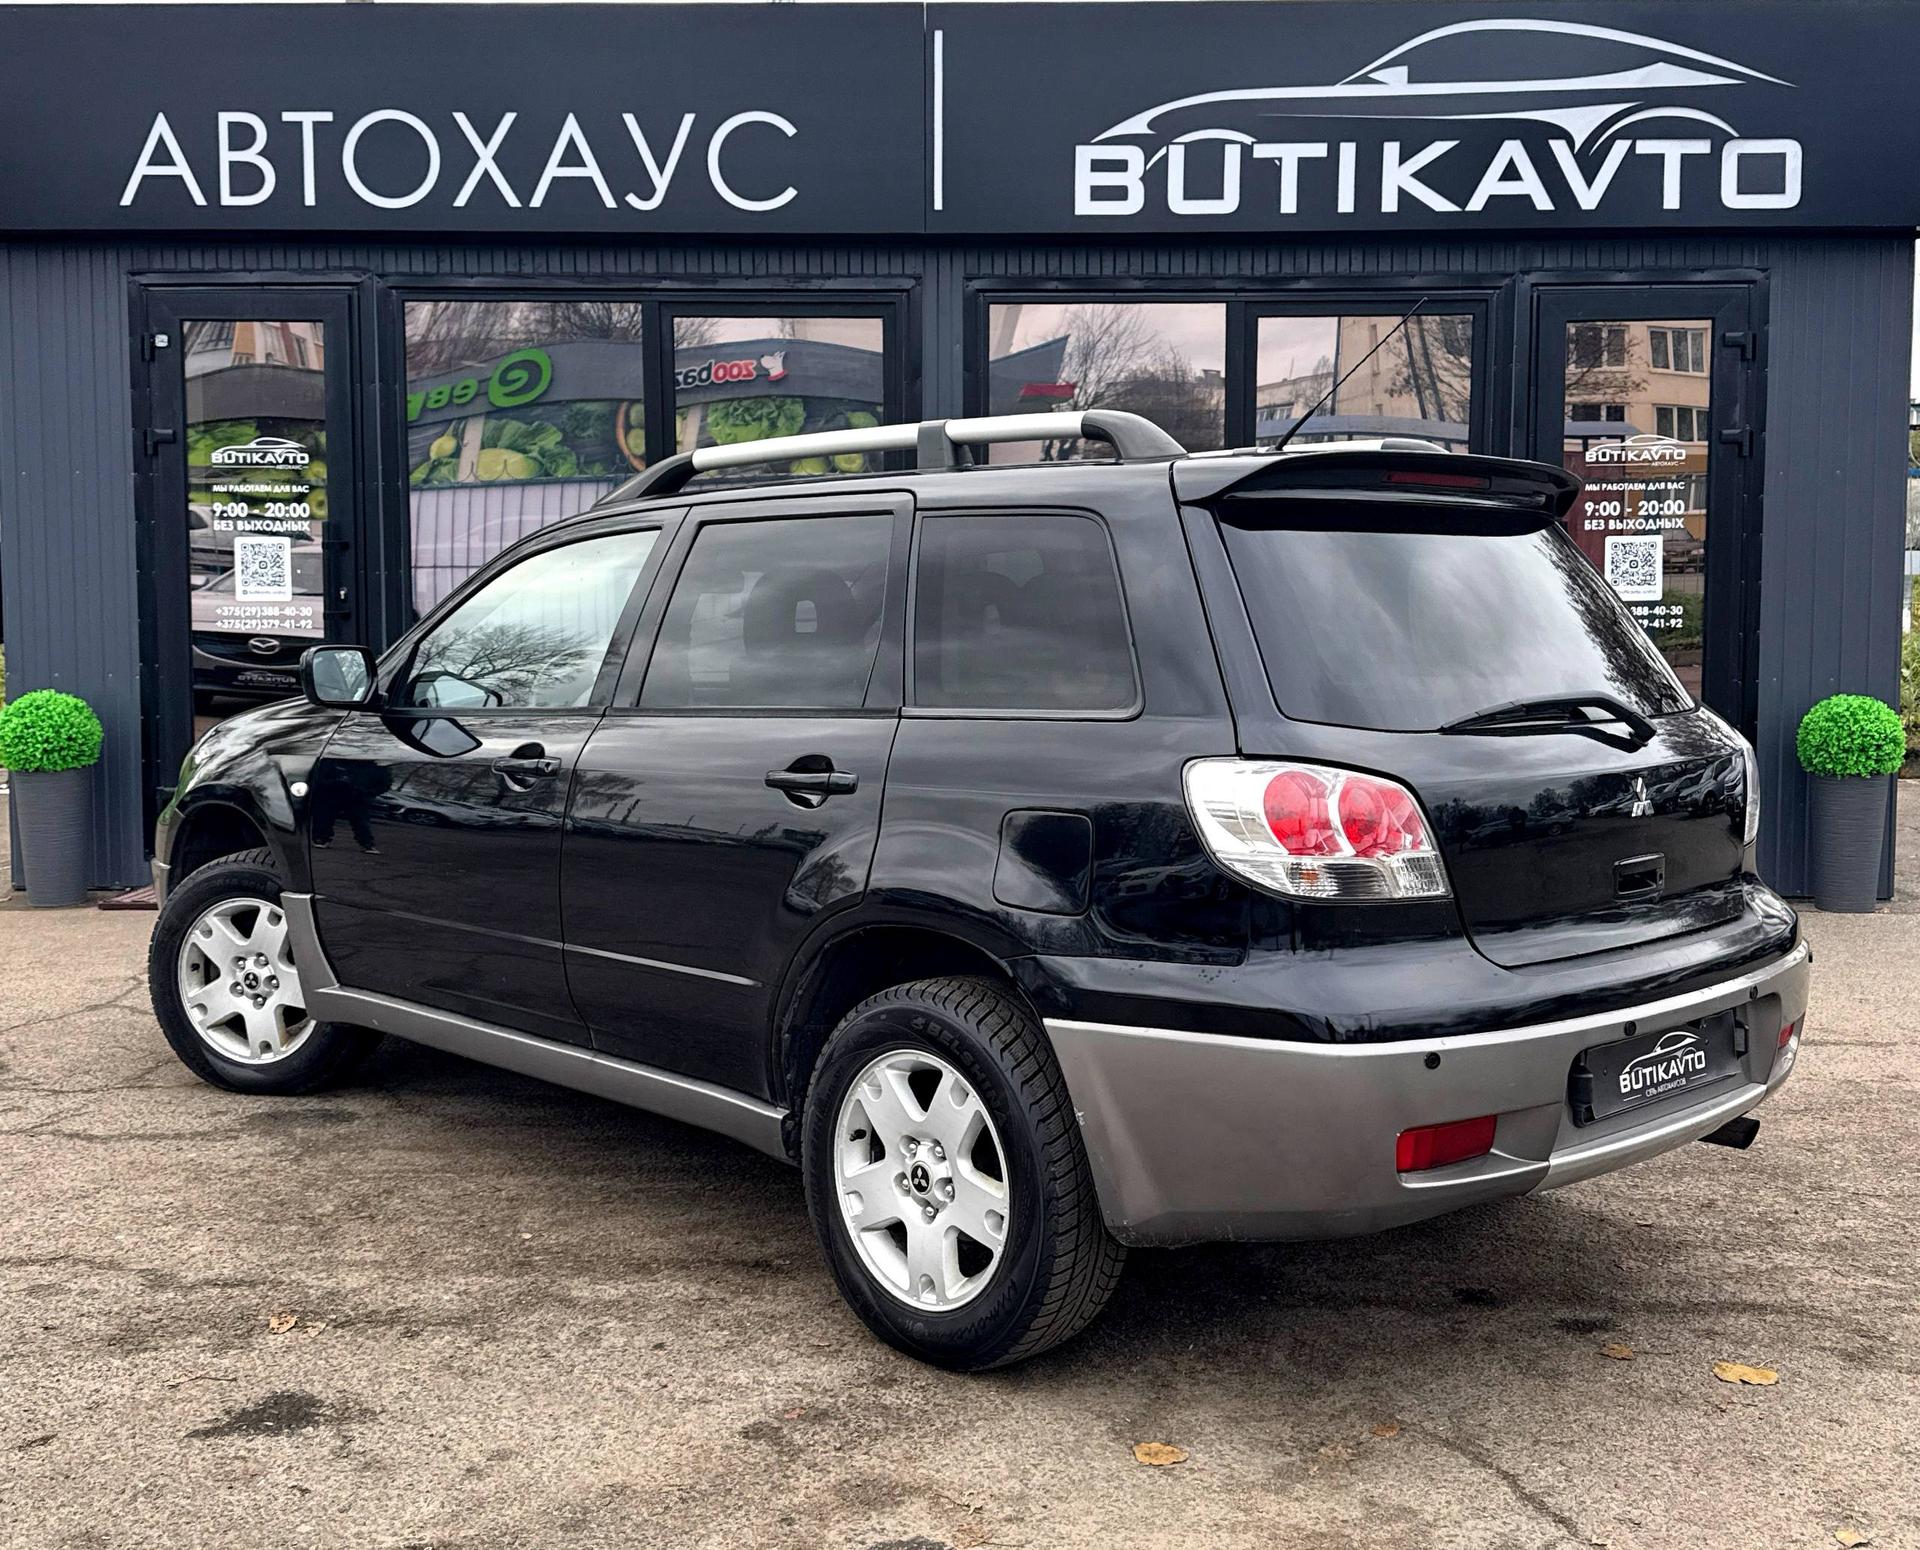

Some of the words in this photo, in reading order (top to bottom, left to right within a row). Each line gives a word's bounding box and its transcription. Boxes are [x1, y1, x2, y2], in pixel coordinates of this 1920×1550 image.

[119, 108, 799, 212] АВТОХАУС
[1073, 138, 1803, 217] BUTIKAVTO
[211, 452, 309, 464] BUTIKAVTO
[1585, 449, 1686, 463] BUTIKAVTO
[212, 485, 228, 493] МЫ
[229, 484, 272, 493] РАБОТАЕМ
[272, 484, 291, 494] ДЛЯ
[292, 485, 310, 493] ВАС
[1585, 483, 1600, 491] МЫ
[1601, 482, 1646, 491] РАБОТАЕМ
[1647, 482, 1666, 491] ДЛЯ
[1667, 482, 1686, 490] ВАС
[212, 502, 249, 518] 9:00
[264, 502, 311, 518] 20:00
[1584, 500, 1621, 517] 9:00
[1637, 500, 1686, 516] 20:00
[213, 520, 234, 531] БЕЗ
[236, 520, 311, 532] ВЫХОДНЫХ
[1584, 519, 1605, 531] БЕЗ
[1608, 518, 1685, 531] ВЫХОДНЫХ
[215, 606, 313, 617] +375(29)388-40-30
[215, 619, 313, 630] +375(29)379-41-92
[1619, 1050, 1706, 1094] BUTIKAVTO
